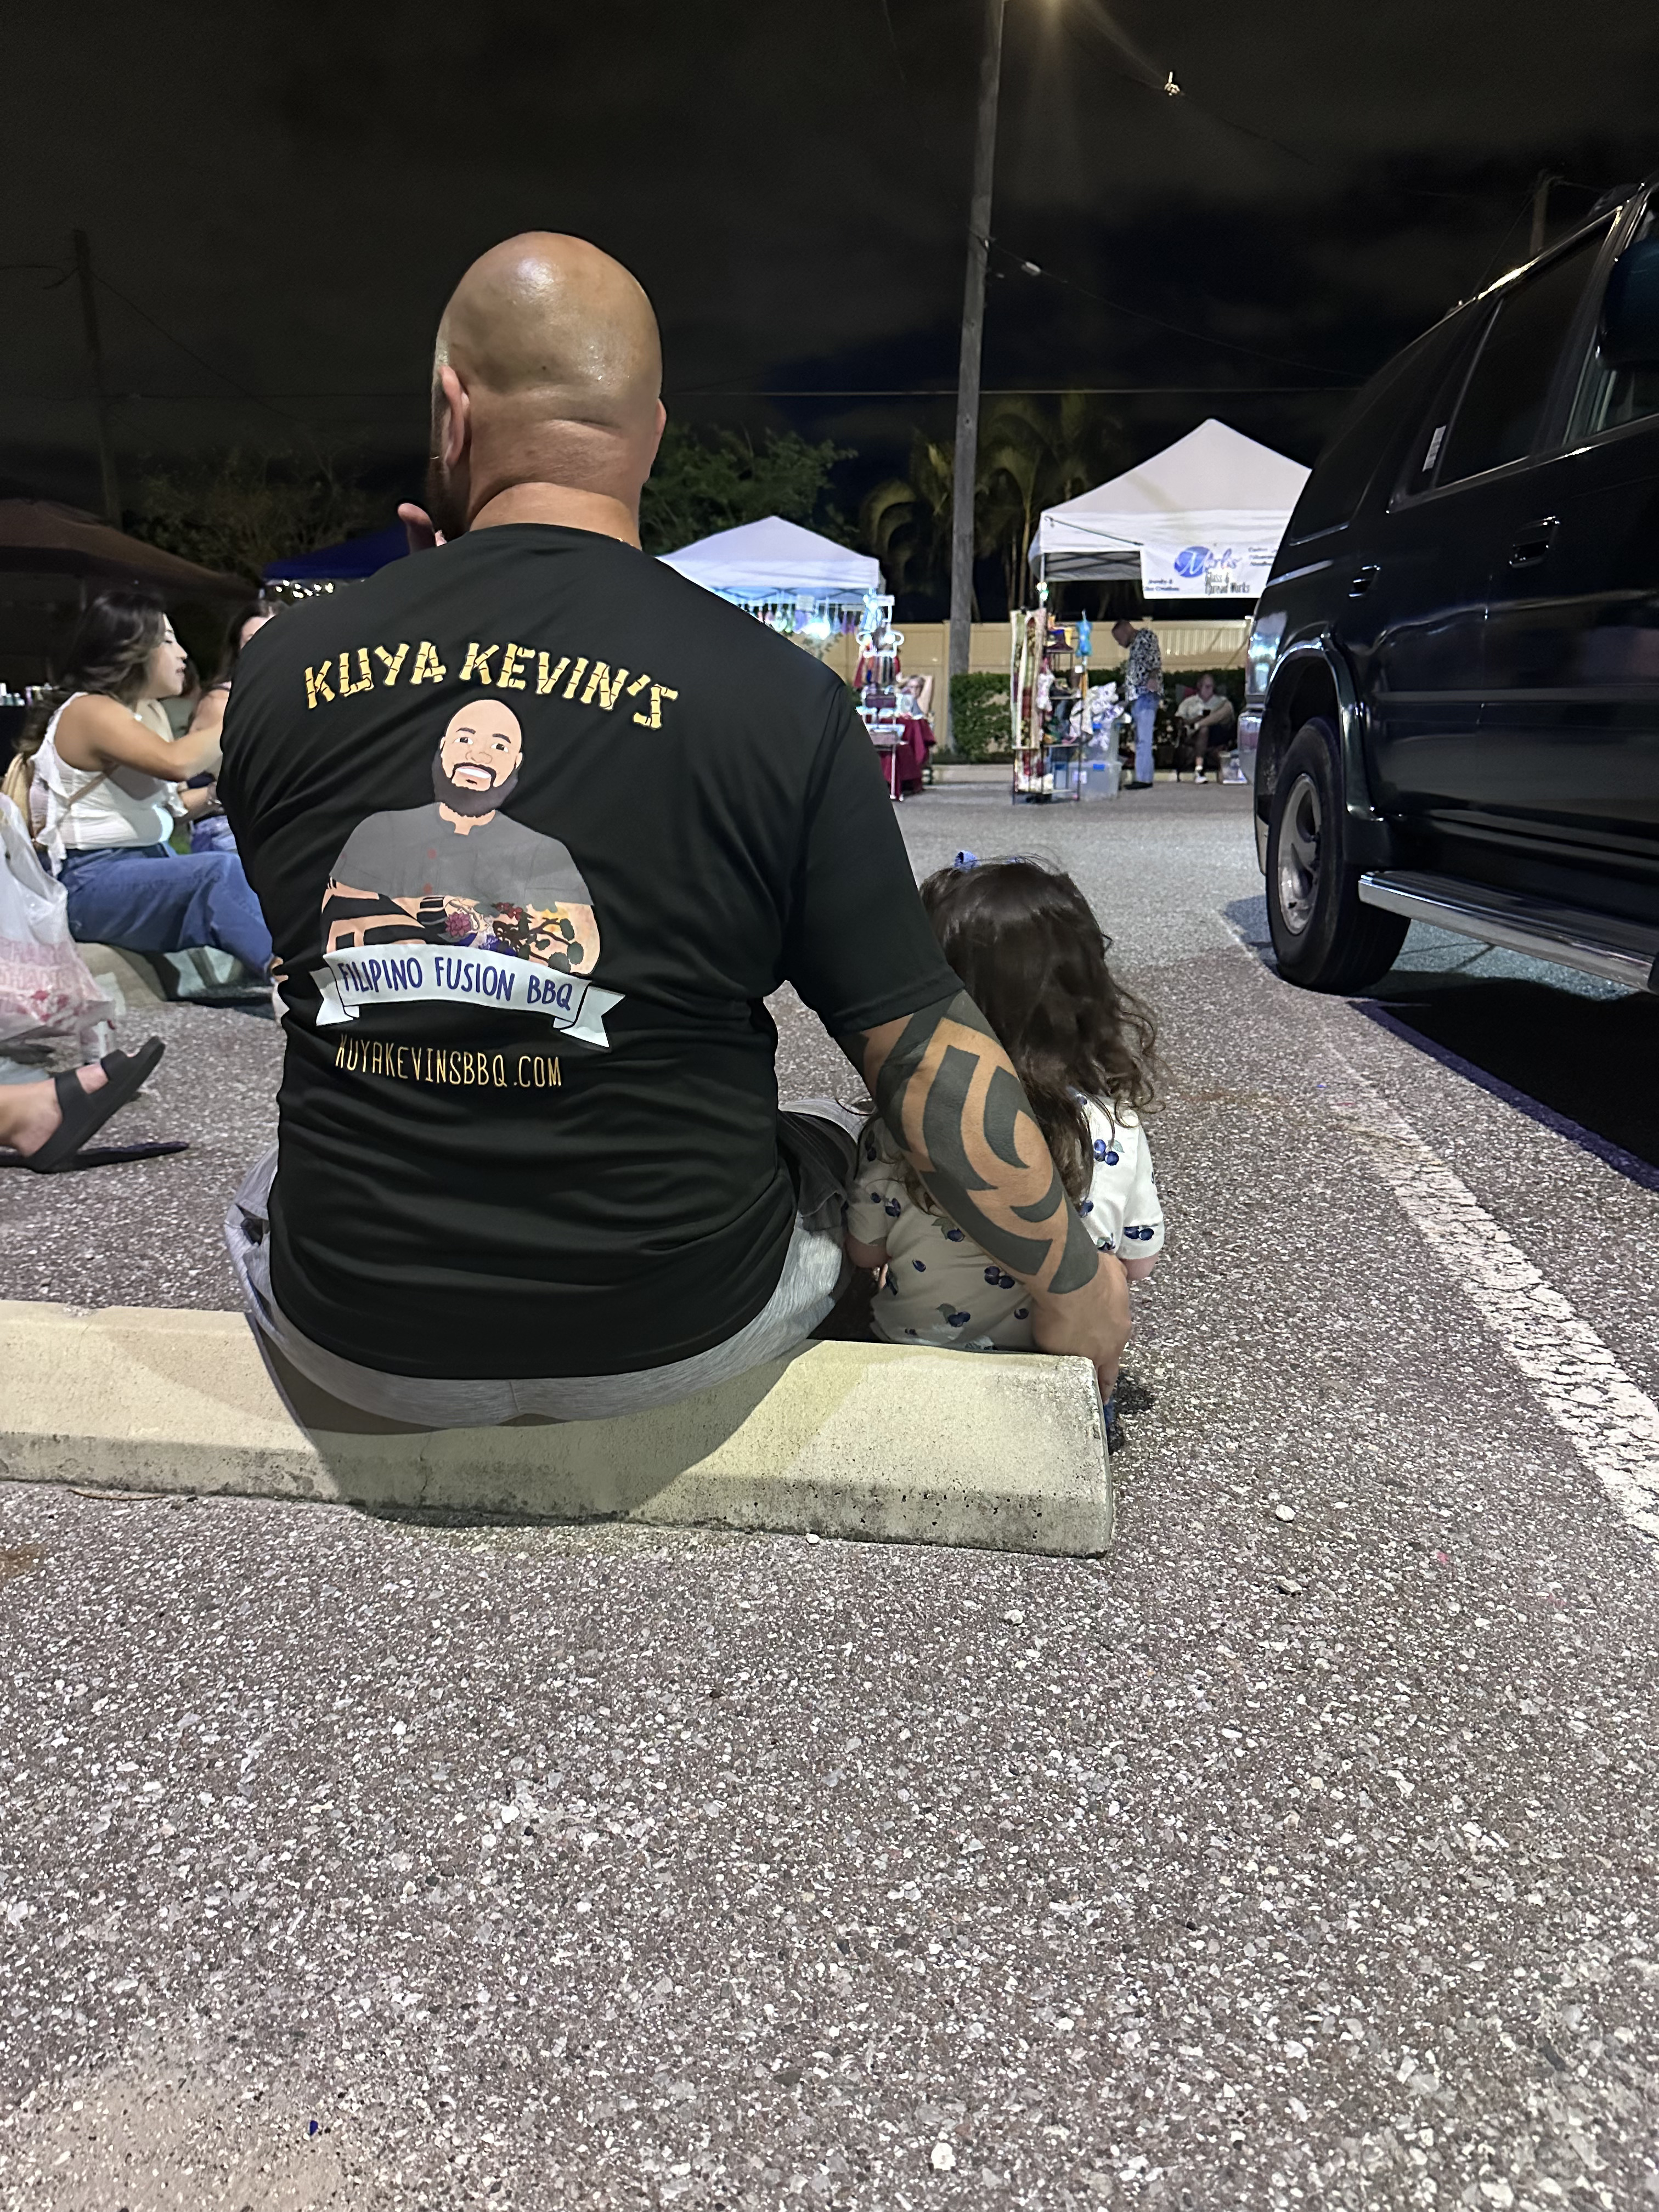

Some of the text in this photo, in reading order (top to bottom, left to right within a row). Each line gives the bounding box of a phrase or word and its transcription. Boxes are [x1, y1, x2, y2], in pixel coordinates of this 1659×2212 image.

[304, 641, 678, 729] KUYA KEVIN'S
[337, 956, 573, 1011] FILIPINO FUSION BBQ
[335, 1034, 562, 1088] KUYAKEVINSBBQ.COM
